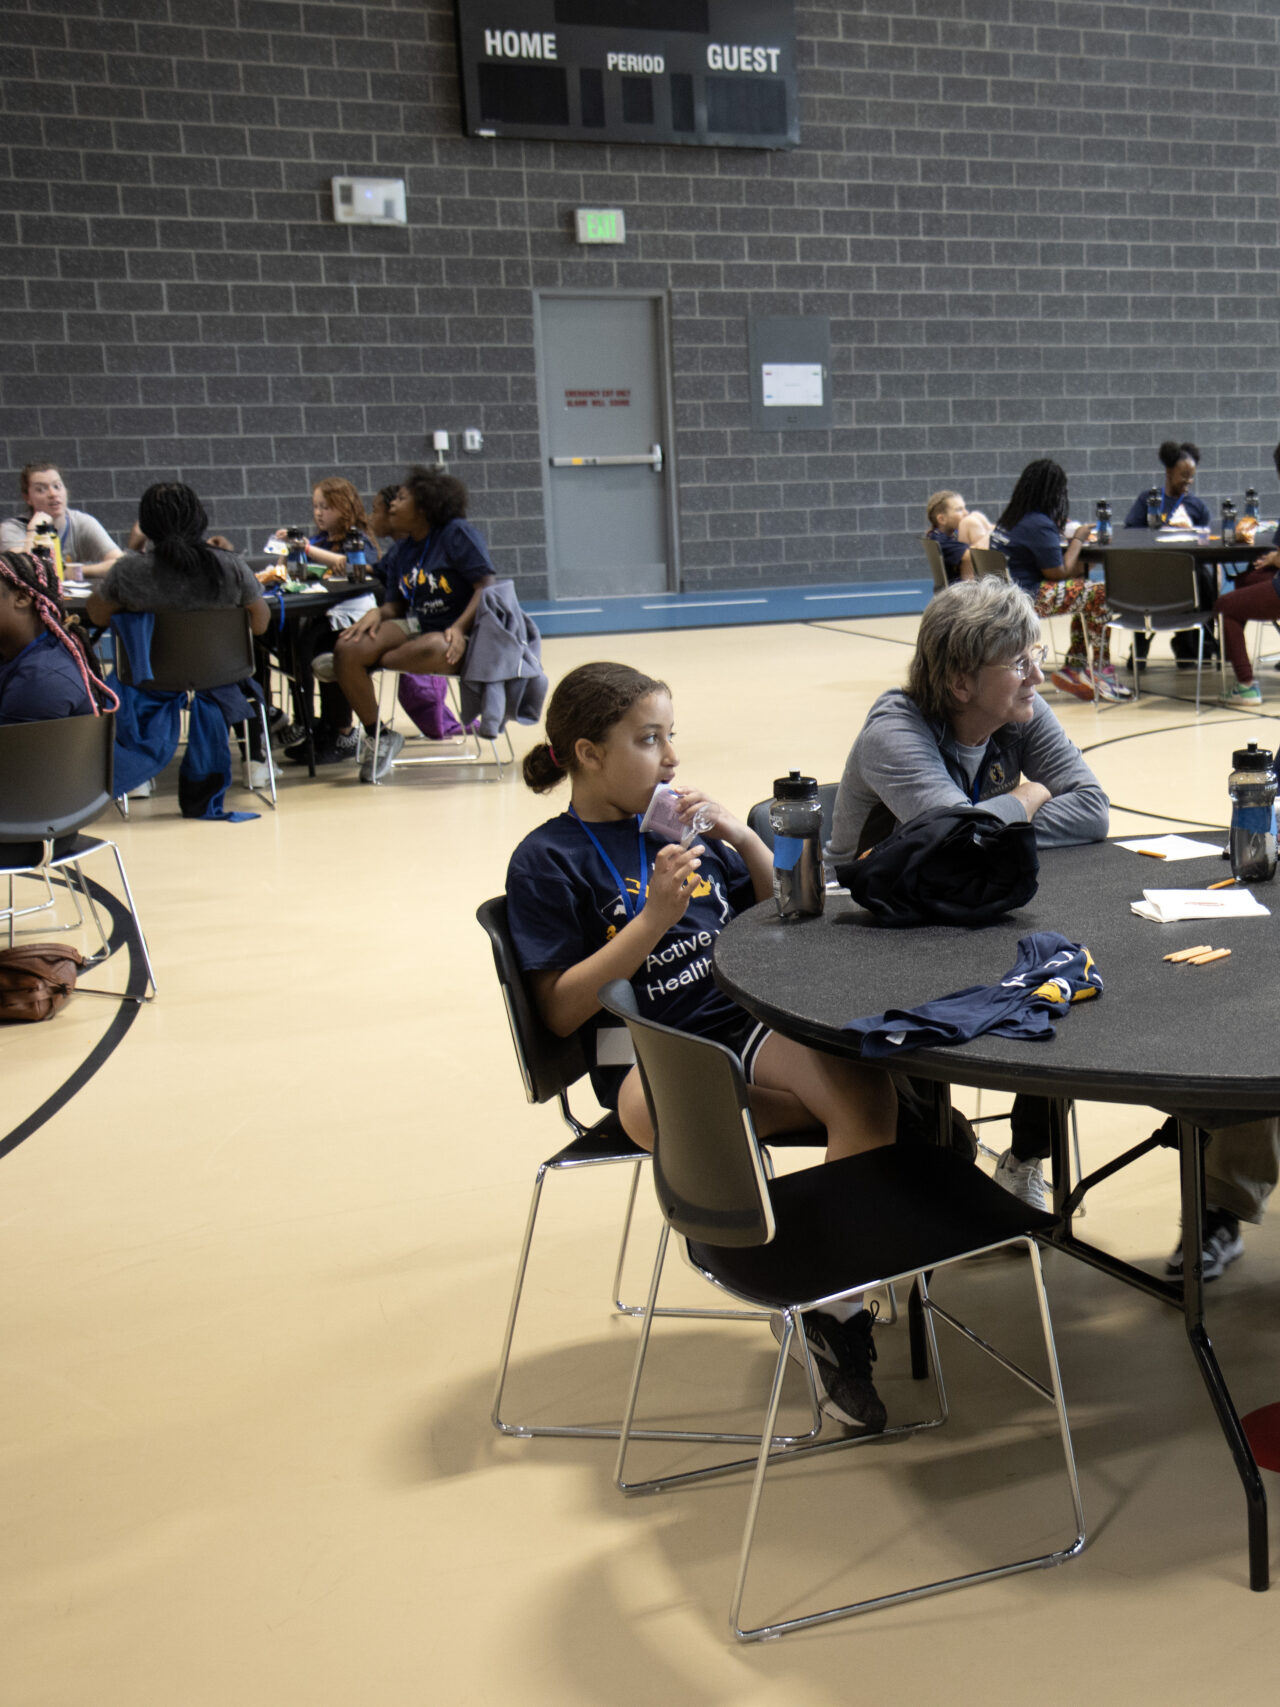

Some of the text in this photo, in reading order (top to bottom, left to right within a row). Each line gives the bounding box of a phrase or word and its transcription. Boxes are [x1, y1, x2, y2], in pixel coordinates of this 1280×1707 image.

[485, 29, 557, 60] HOME
[707, 44, 780, 73] GUEST
[606, 53, 665, 74] PERIOD
[587, 215, 617, 239] EXIT
[647, 931, 712, 973] Active
